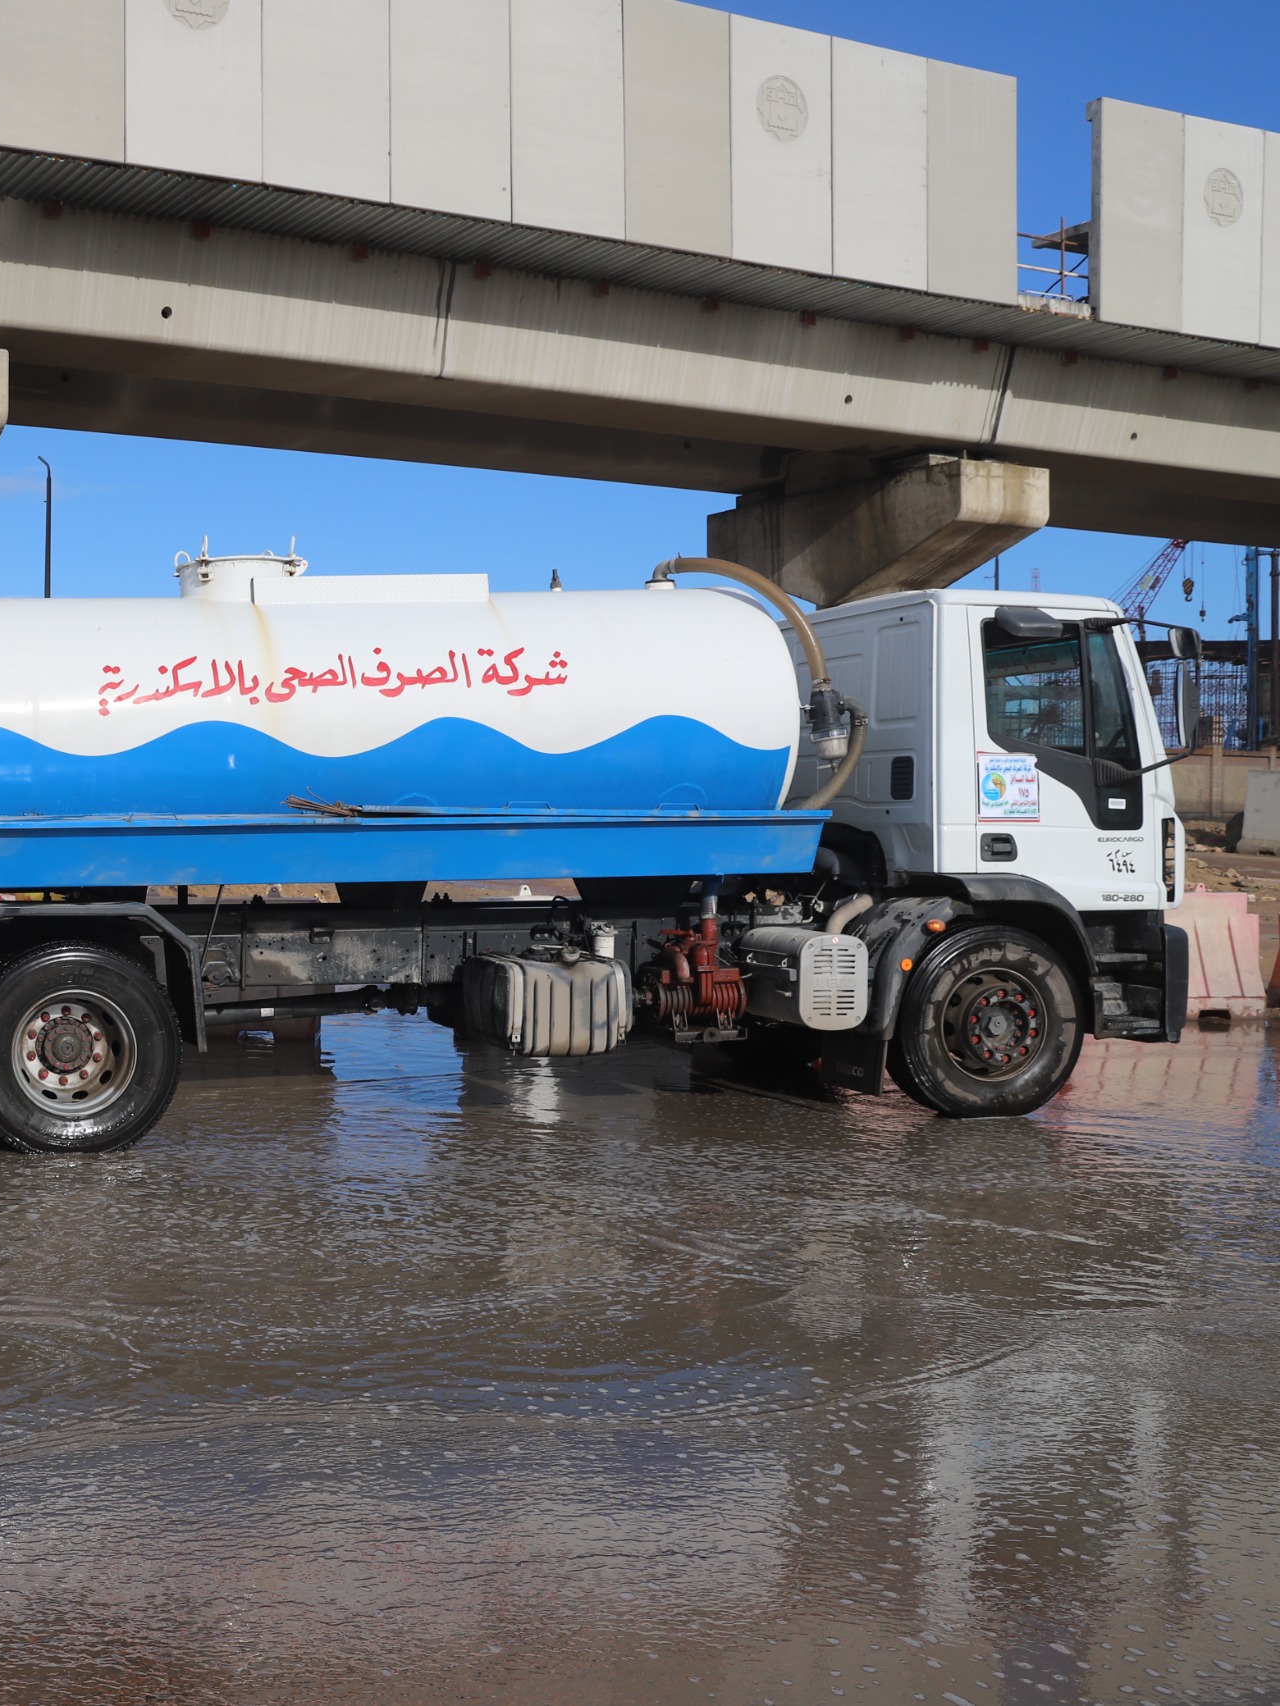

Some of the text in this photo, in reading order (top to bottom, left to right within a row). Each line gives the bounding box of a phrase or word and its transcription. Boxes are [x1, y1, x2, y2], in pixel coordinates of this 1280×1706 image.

[361, 647, 471, 698] الصرف
[477, 647, 568, 697] شركة
[1109, 858, 1136, 874] ٦٤٩٤
[812, 976, 856, 989] IVECO
[835, 1061, 865, 1078] ECO
